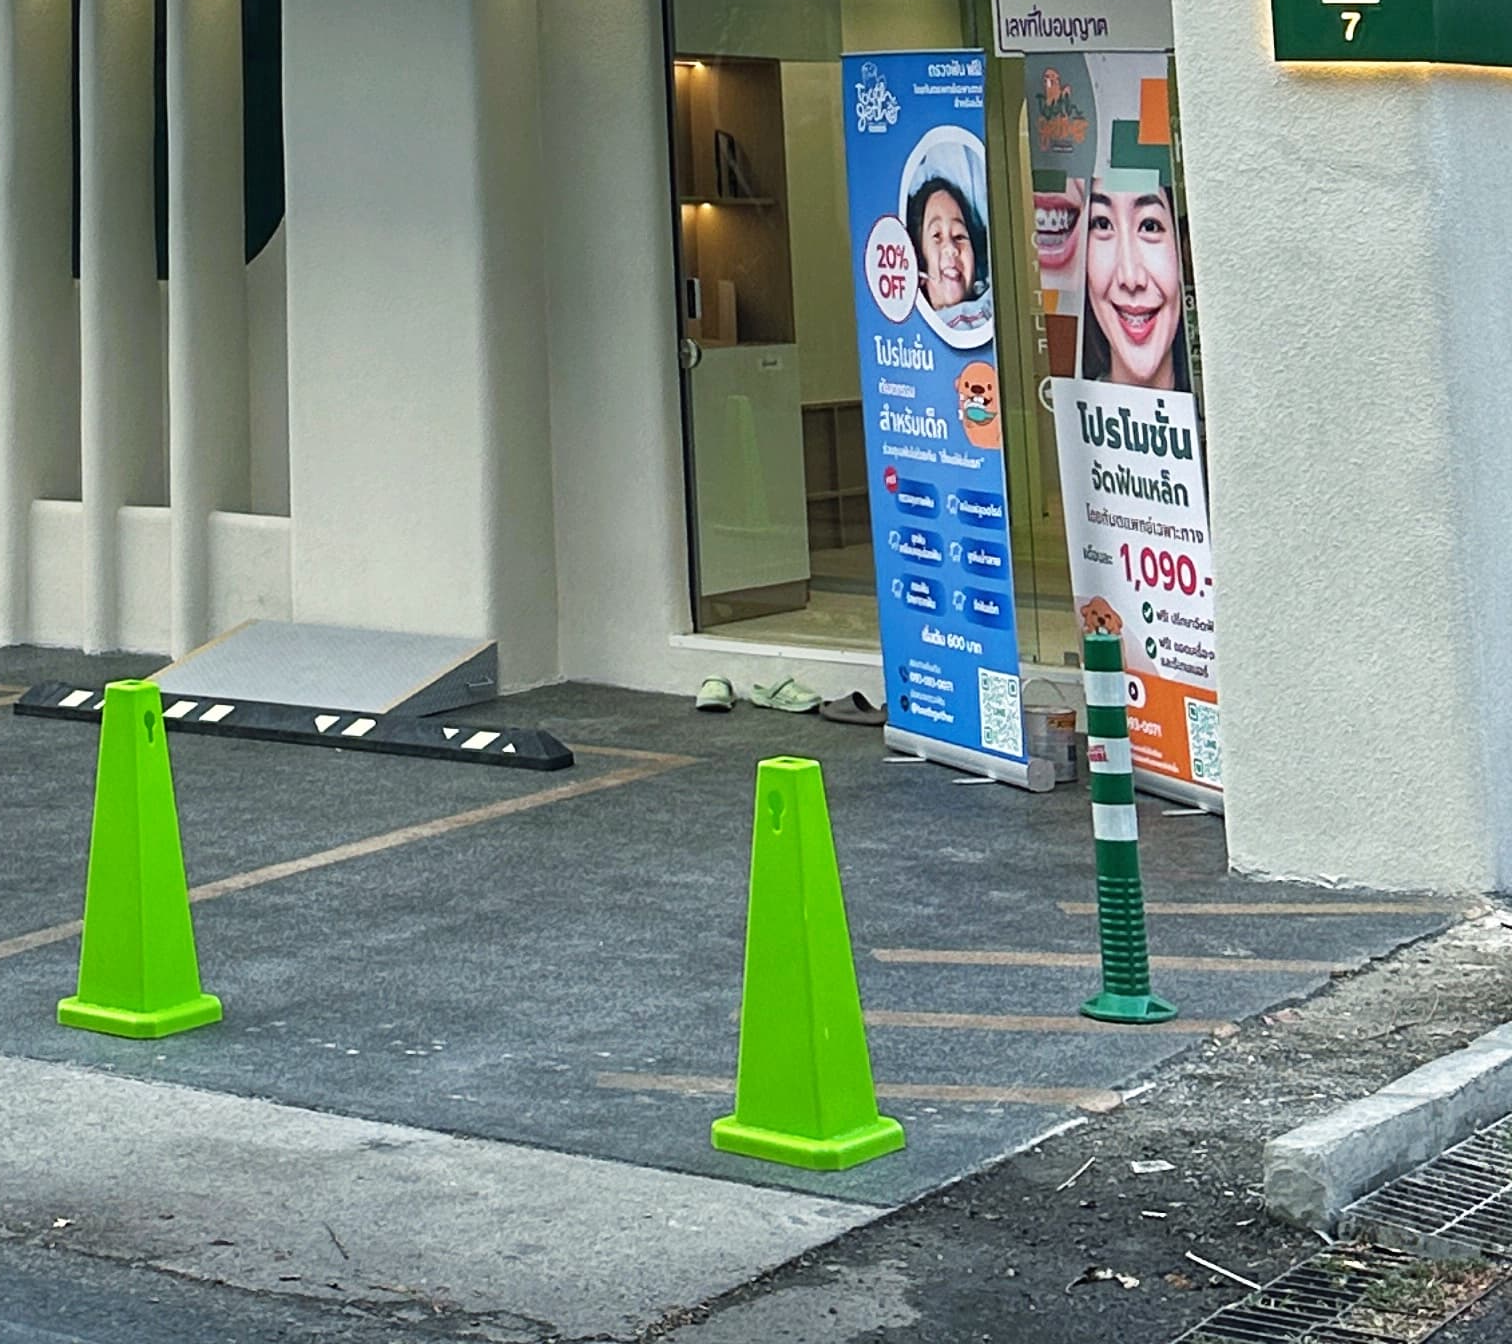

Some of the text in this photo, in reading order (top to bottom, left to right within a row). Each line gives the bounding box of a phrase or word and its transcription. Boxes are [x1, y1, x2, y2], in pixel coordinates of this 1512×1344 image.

[876, 243, 909, 270] 20%
[879, 274, 906, 300] OFF
[874, 333, 934, 371] โปรโมชั่น
[879, 403, 948, 440] สำหรับเด็ก
[1076, 398, 1193, 461] โปรโมชั่น
[1091, 459, 1190, 508] จัดฟันเหล็ก
[947, 633, 965, 651] 600
